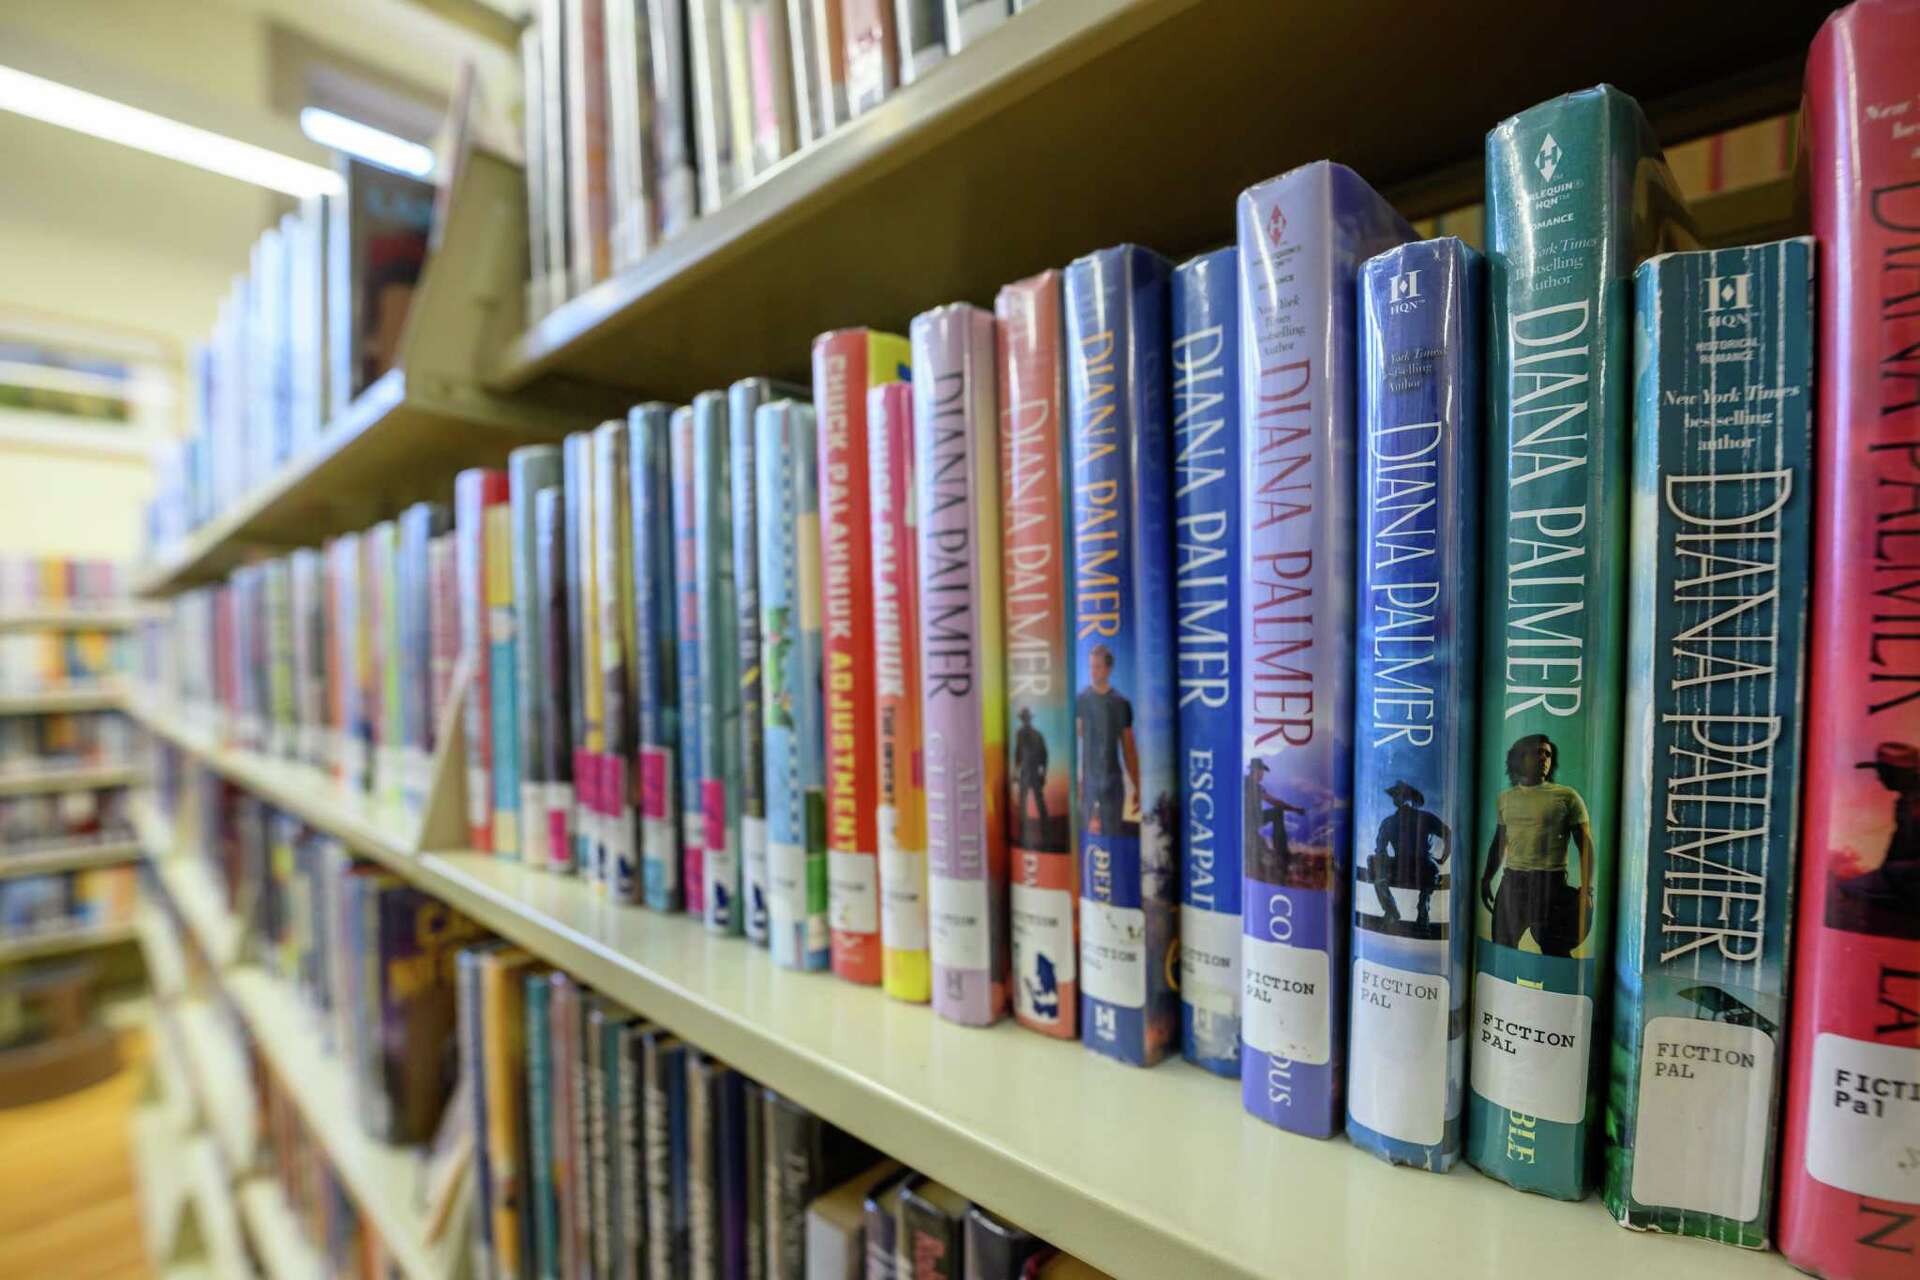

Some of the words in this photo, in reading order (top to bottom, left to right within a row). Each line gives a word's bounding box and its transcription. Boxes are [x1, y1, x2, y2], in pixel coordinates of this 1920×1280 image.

[1390, 301, 1419, 316] HQN
[1708, 313, 1749, 328] HQN
[825, 353, 849, 452] CHUCK
[929, 371, 967, 514] DIANA
[1079, 330, 1116, 467] DIANA
[1172, 324, 1225, 498] DIANA
[1253, 359, 1312, 531] DIANA
[1511, 299, 1590, 486] DIANA
[1663, 390, 1697, 406] New
[1703, 387, 1741, 405] York
[1745, 383, 1800, 401] Times
[1697, 434, 1756, 451] author
[1003, 398, 1049, 536] DIANA
[1370, 420, 1442, 570] DIANA
[826, 462, 852, 639] PALAHNIUK
[928, 527, 973, 699] PALMER
[1076, 479, 1121, 641] PALMER
[1177, 511, 1230, 709] PALMER
[1504, 504, 1587, 720] PALMER
[1666, 468, 1792, 691] DIANA
[1005, 543, 1052, 698] PALMER
[1253, 549, 1314, 747] PALMER
[1371, 581, 1440, 748] PALMER
[1660, 713, 1781, 963] PALMER
[1246, 968, 1316, 996] FICTION
[1246, 984, 1271, 1004] PAL
[1360, 988, 1391, 1009] PAL
[1361, 970, 1440, 1001] FICTION
[1481, 1031, 1517, 1056] PAL
[1482, 1012, 1576, 1050] FICTION
[1655, 1062, 1694, 1080] PAL
[1656, 1043, 1756, 1069] FICTION
[1834, 1089, 1885, 1118] Pal
